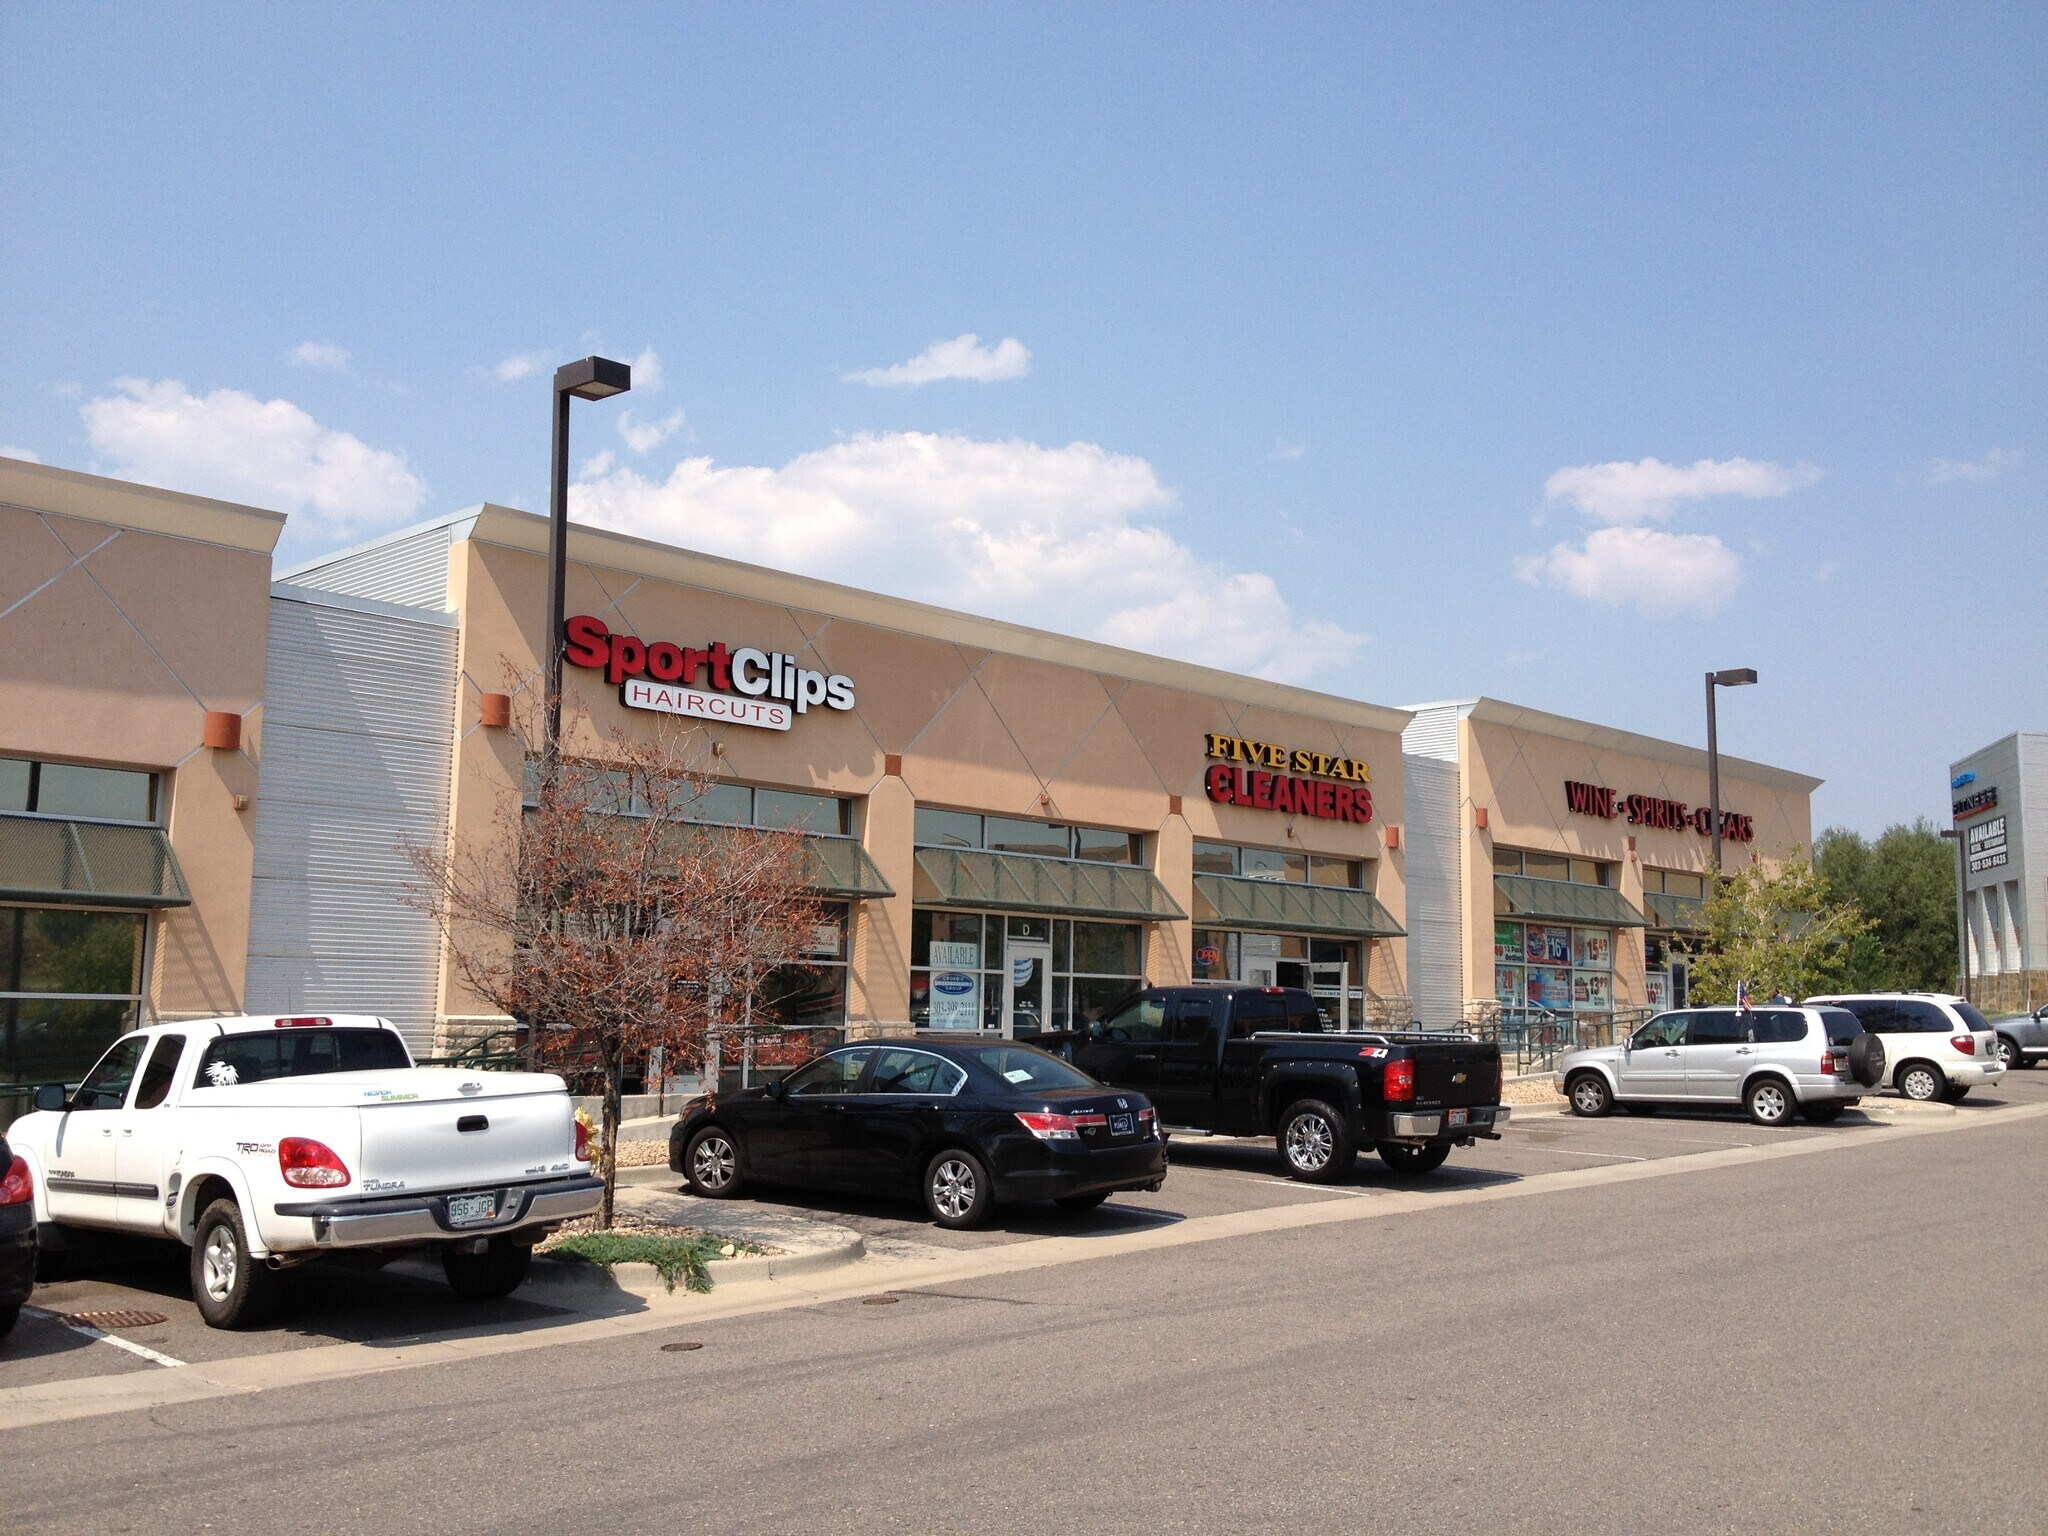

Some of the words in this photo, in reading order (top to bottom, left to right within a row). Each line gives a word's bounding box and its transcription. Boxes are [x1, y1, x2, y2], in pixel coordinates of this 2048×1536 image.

[632, 685, 784, 725] HAIRCUTS
[1205, 733, 1288, 768] FIVE
[1290, 750, 1372, 783] STAR
[1205, 764, 1373, 824] CLEANERS
[1565, 780, 1617, 819] WINE
[1627, 794, 1688, 831] SPIRITS
[1695, 807, 1755, 843] CGARS
[1970, 818, 2005, 844] AVAILABLE
[1022, 924, 1030, 936] D
[933, 945, 974, 965] AVAILABLE
[363, 1180, 405, 1192] TUNDRA
